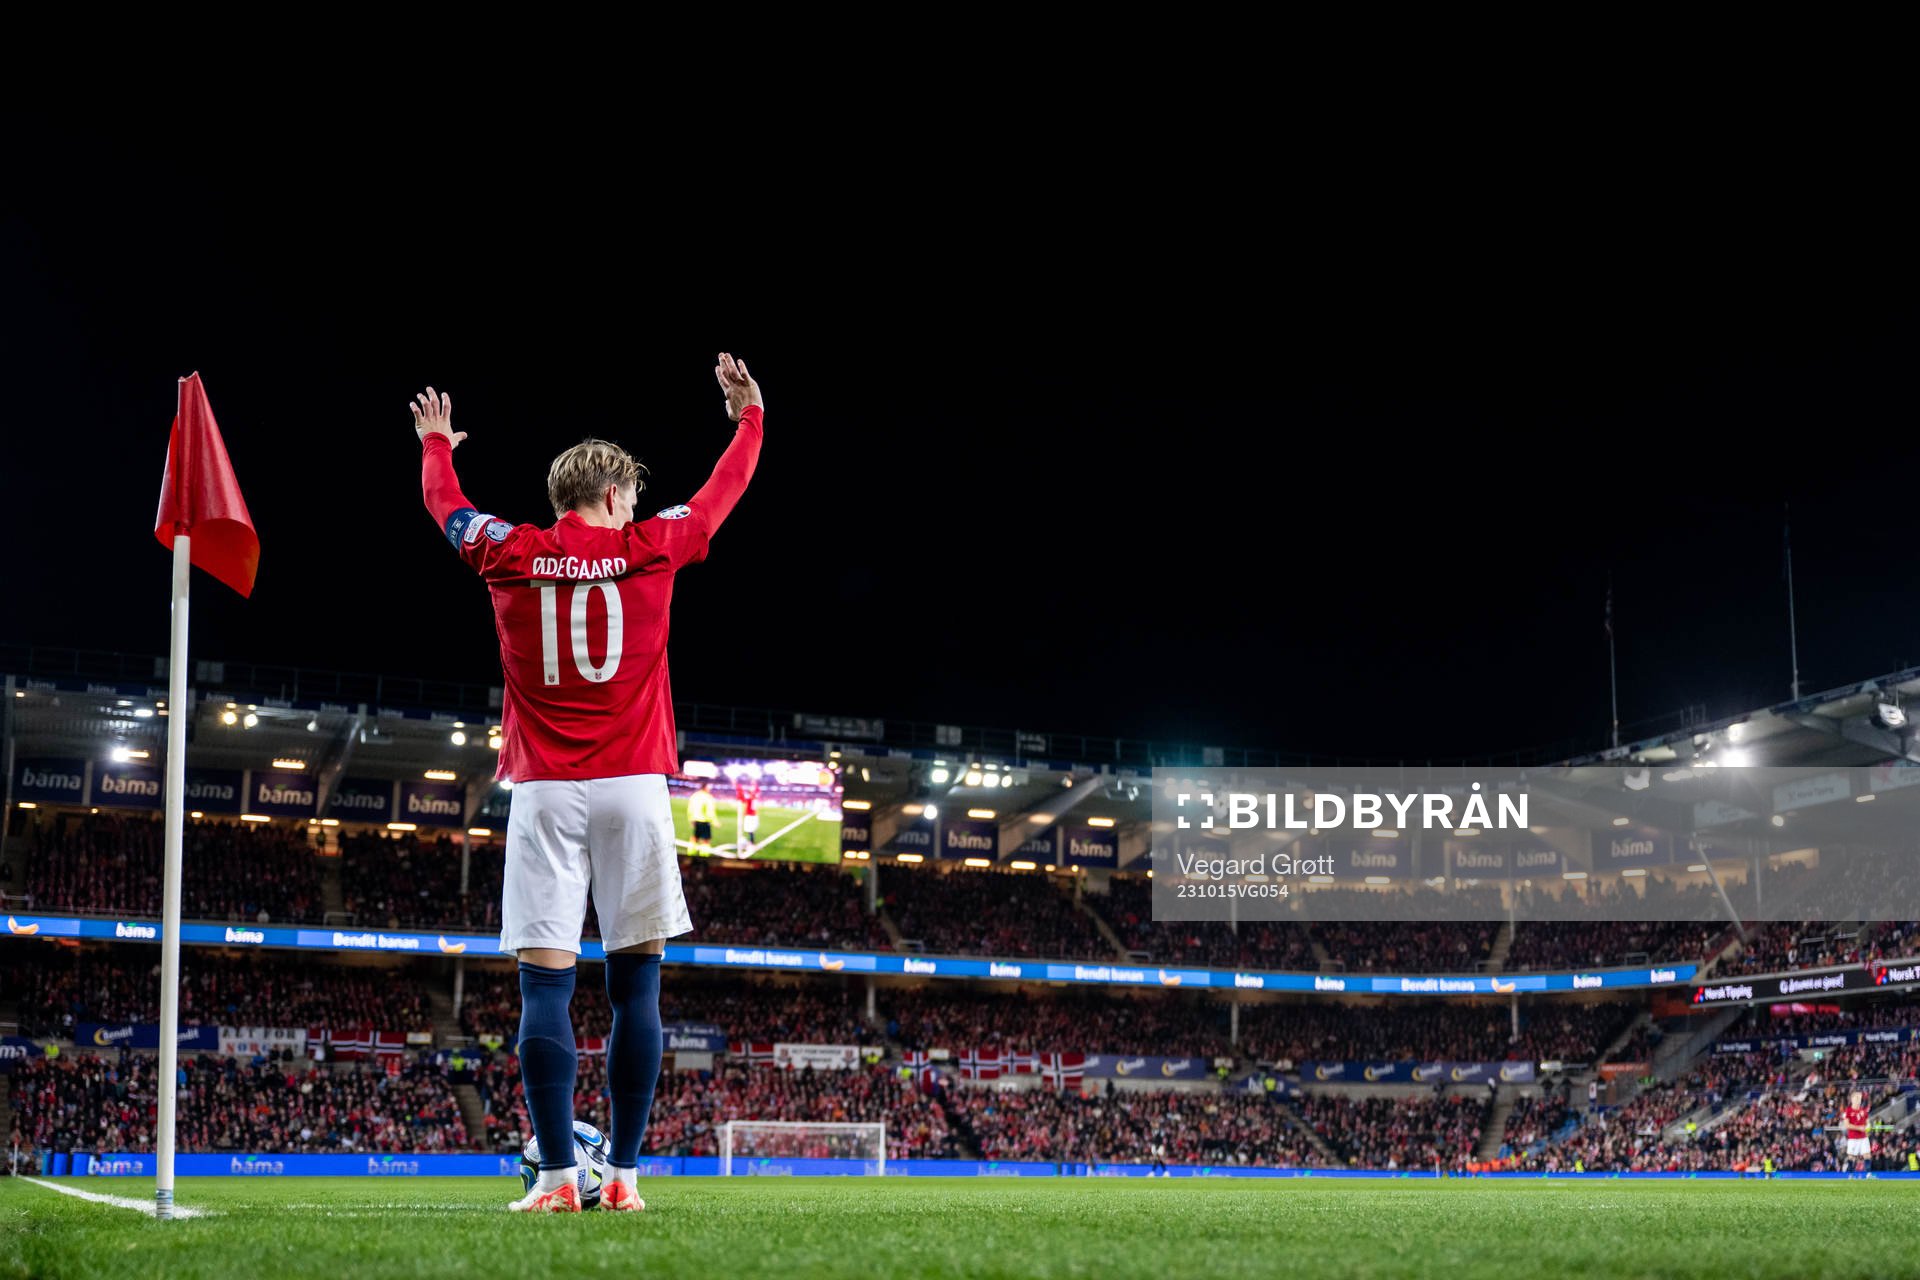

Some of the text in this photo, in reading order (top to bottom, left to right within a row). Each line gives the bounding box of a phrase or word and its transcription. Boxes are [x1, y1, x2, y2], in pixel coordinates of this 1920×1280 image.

[532, 556, 627, 579] ØDEGAARD
[530, 578, 623, 685] 10
[22, 767, 81, 790] bama
[101, 774, 159, 796] bama
[258, 783, 314, 806] bama
[408, 793, 461, 816] bama
[842, 826, 868, 842] ma
[948, 830, 992, 852] bama
[1070, 838, 1113, 859] bama
[1611, 839, 1654, 858] bama
[116, 921, 156, 938] bama
[225, 926, 265, 943] bama
[333, 931, 419, 950] Bendit banan
[725, 949, 803, 966] Bendit banan
[903, 957, 936, 974] bama
[990, 960, 1021, 978] bama
[1074, 965, 1144, 982] Bendit banan
[1889, 966, 1914, 982] Norsk
[1401, 977, 1475, 991] Bendit banan
[1704, 984, 1752, 1000] Norsk Tipping
[669, 1033, 708, 1049] bama
[0, 1045, 27, 1059] ma
[88, 1155, 143, 1174] bama
[231, 1156, 284, 1174] bama
[368, 1156, 419, 1174] bama
